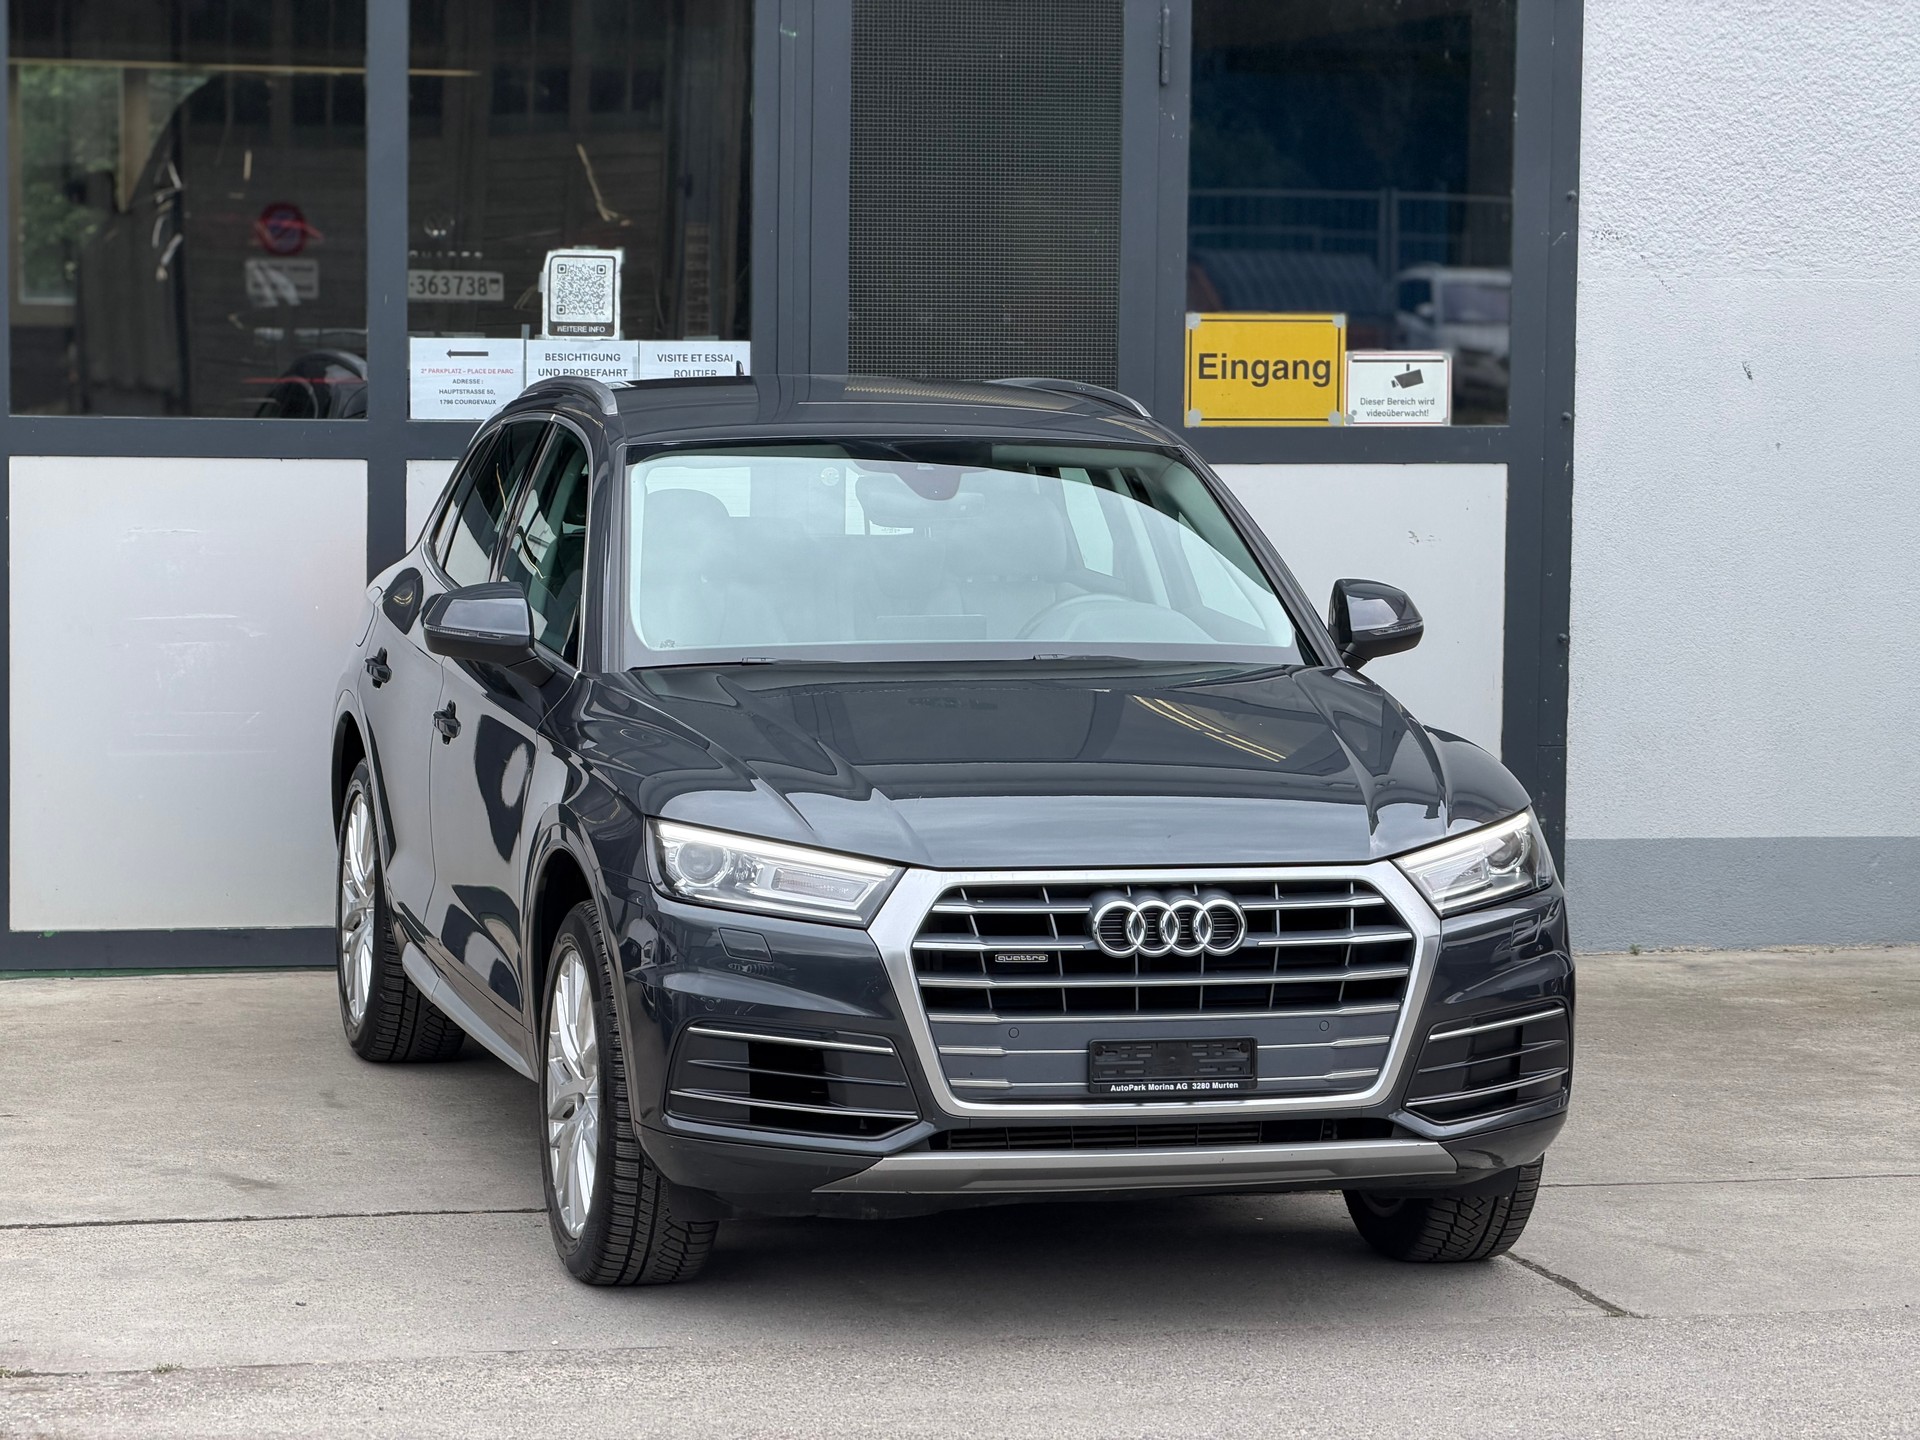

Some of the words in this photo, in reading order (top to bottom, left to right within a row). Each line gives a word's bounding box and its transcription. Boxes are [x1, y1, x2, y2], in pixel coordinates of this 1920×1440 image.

[544, 353, 621, 361] BESICHTIGUNG
[657, 353, 689, 362] VISITE
[691, 354, 703, 362] ET
[705, 354, 733, 362] ESSAI
[538, 368, 560, 376] UND
[562, 368, 628, 377] PROBEFAHRT
[1198, 353, 1331, 387] Eingang
[1359, 397, 1385, 405] Dieser
[1387, 397, 1416, 405] Bereich
[1417, 397, 1435, 405] wird
[1366, 408, 1429, 417] videoüberwacht!
[1110, 1083, 1146, 1092] AutoPark
[1148, 1083, 1174, 1091] Morina
[1176, 1082, 1188, 1090] AG
[1192, 1082, 1210, 1090] 3280
